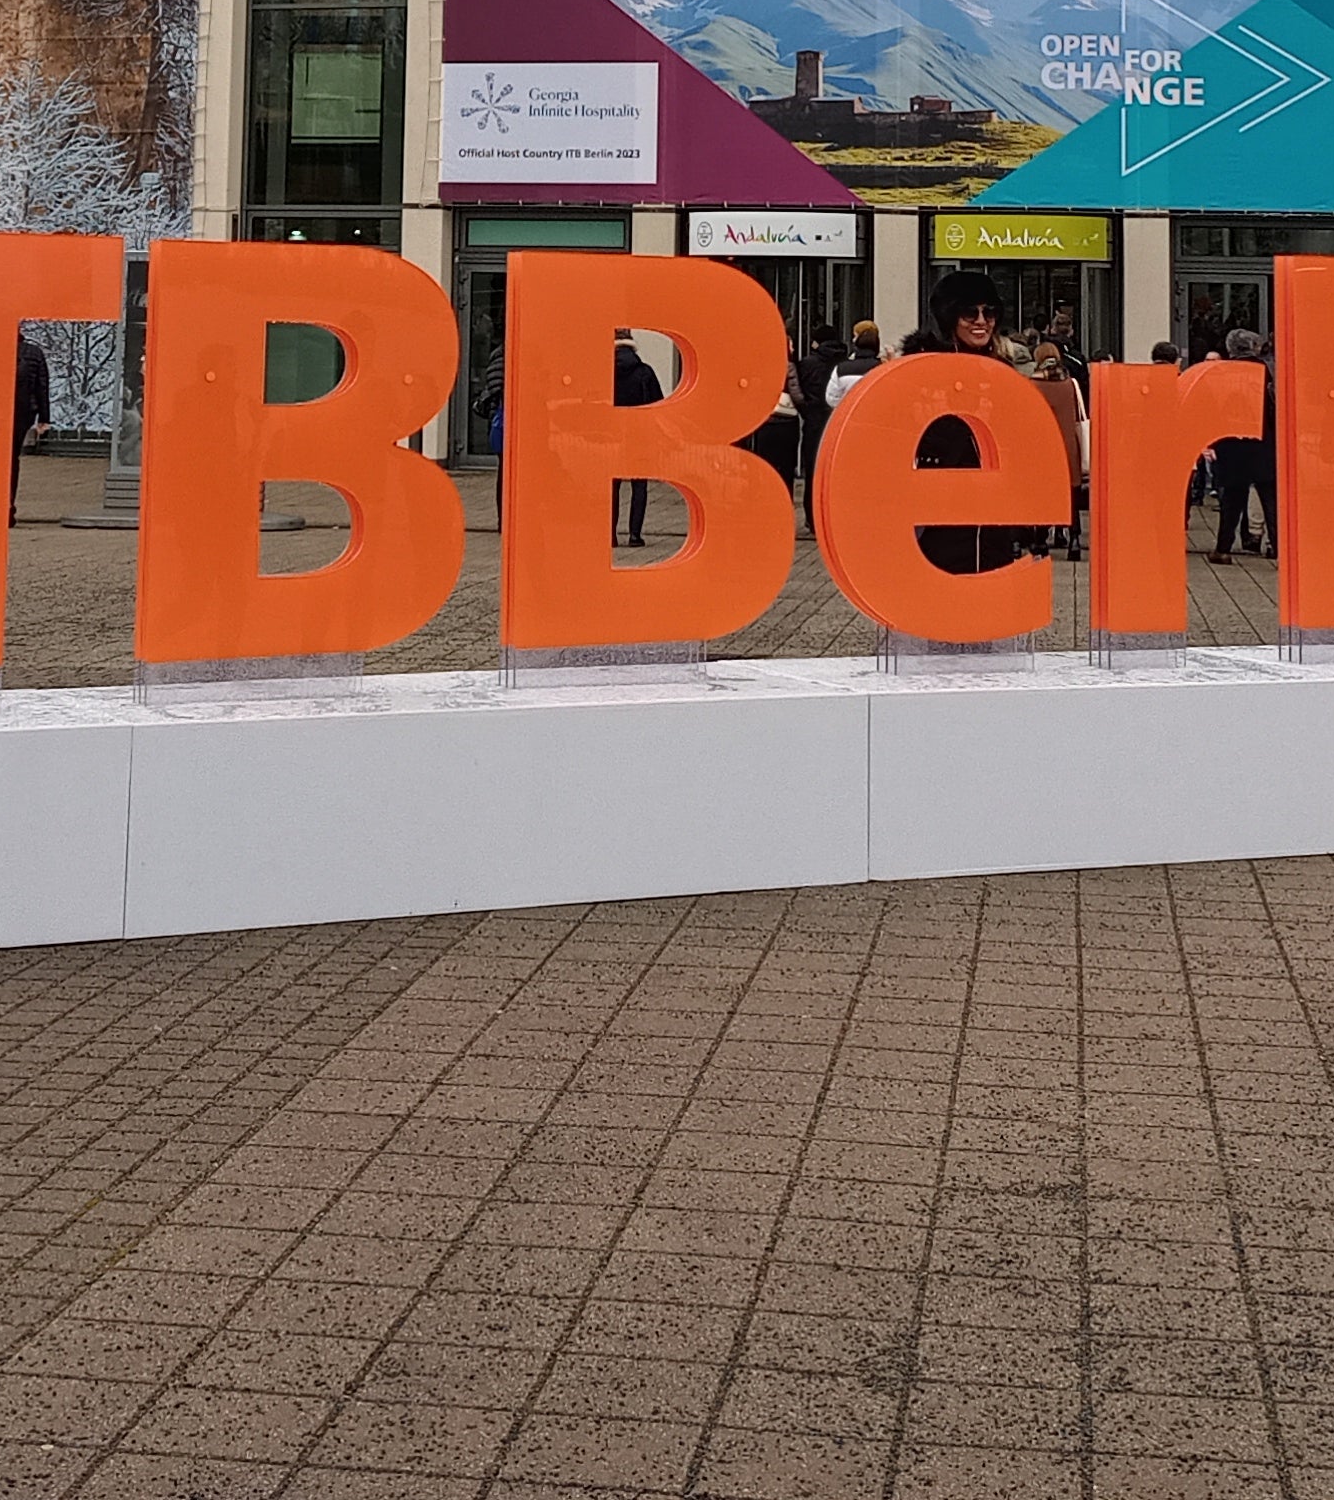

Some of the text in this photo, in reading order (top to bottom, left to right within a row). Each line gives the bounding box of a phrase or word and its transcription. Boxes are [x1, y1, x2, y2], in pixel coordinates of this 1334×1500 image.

[1040, 34, 1182, 72] OPEN FOR
[528, 87, 579, 103] Georgia
[528, 104, 641, 120] Infinite Hospitality
[458, 148, 640, 160] Official Host Country ITB Berlin 2023
[724, 223, 807, 245] Andalucía
[977, 225, 1064, 249] Andalucía
